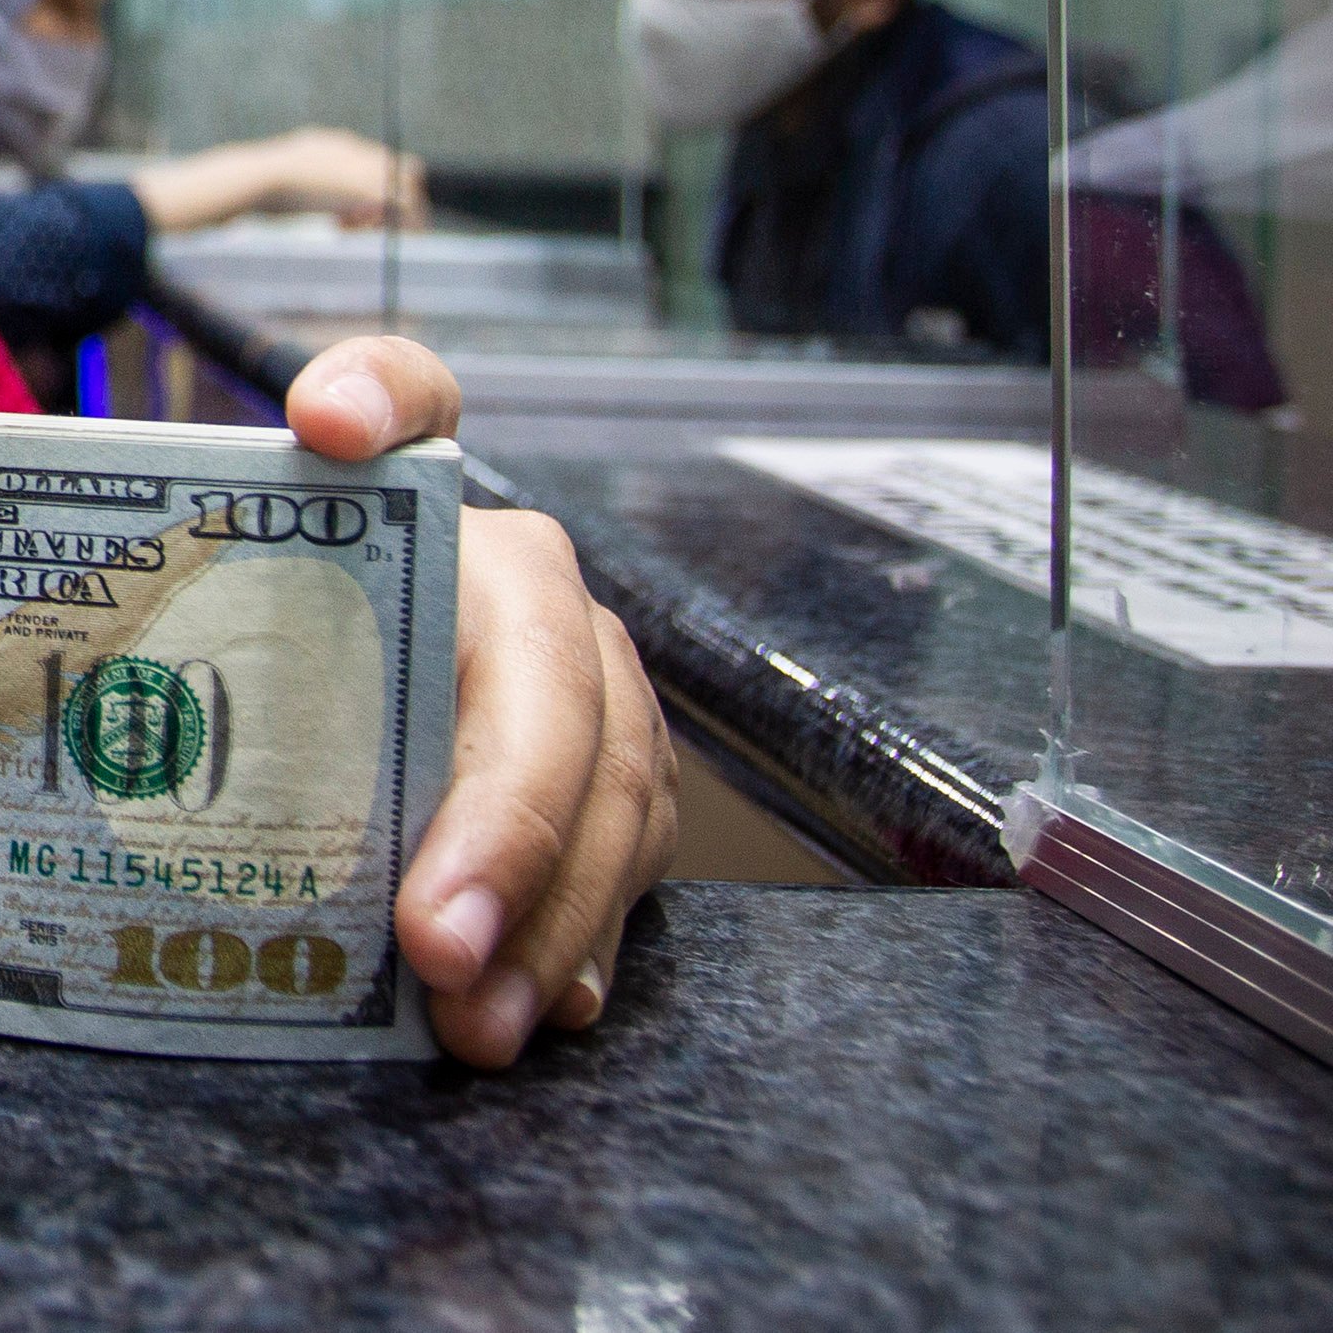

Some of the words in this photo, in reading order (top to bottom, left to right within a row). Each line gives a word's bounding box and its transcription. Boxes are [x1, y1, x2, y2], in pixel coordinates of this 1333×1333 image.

[189, 491, 368, 546] 100
[4, 624, 31, 637] AND
[36, 627, 90, 642] PRIVATE
[8, 613, 60, 627] TENDER
[102, 925, 347, 995] 100
